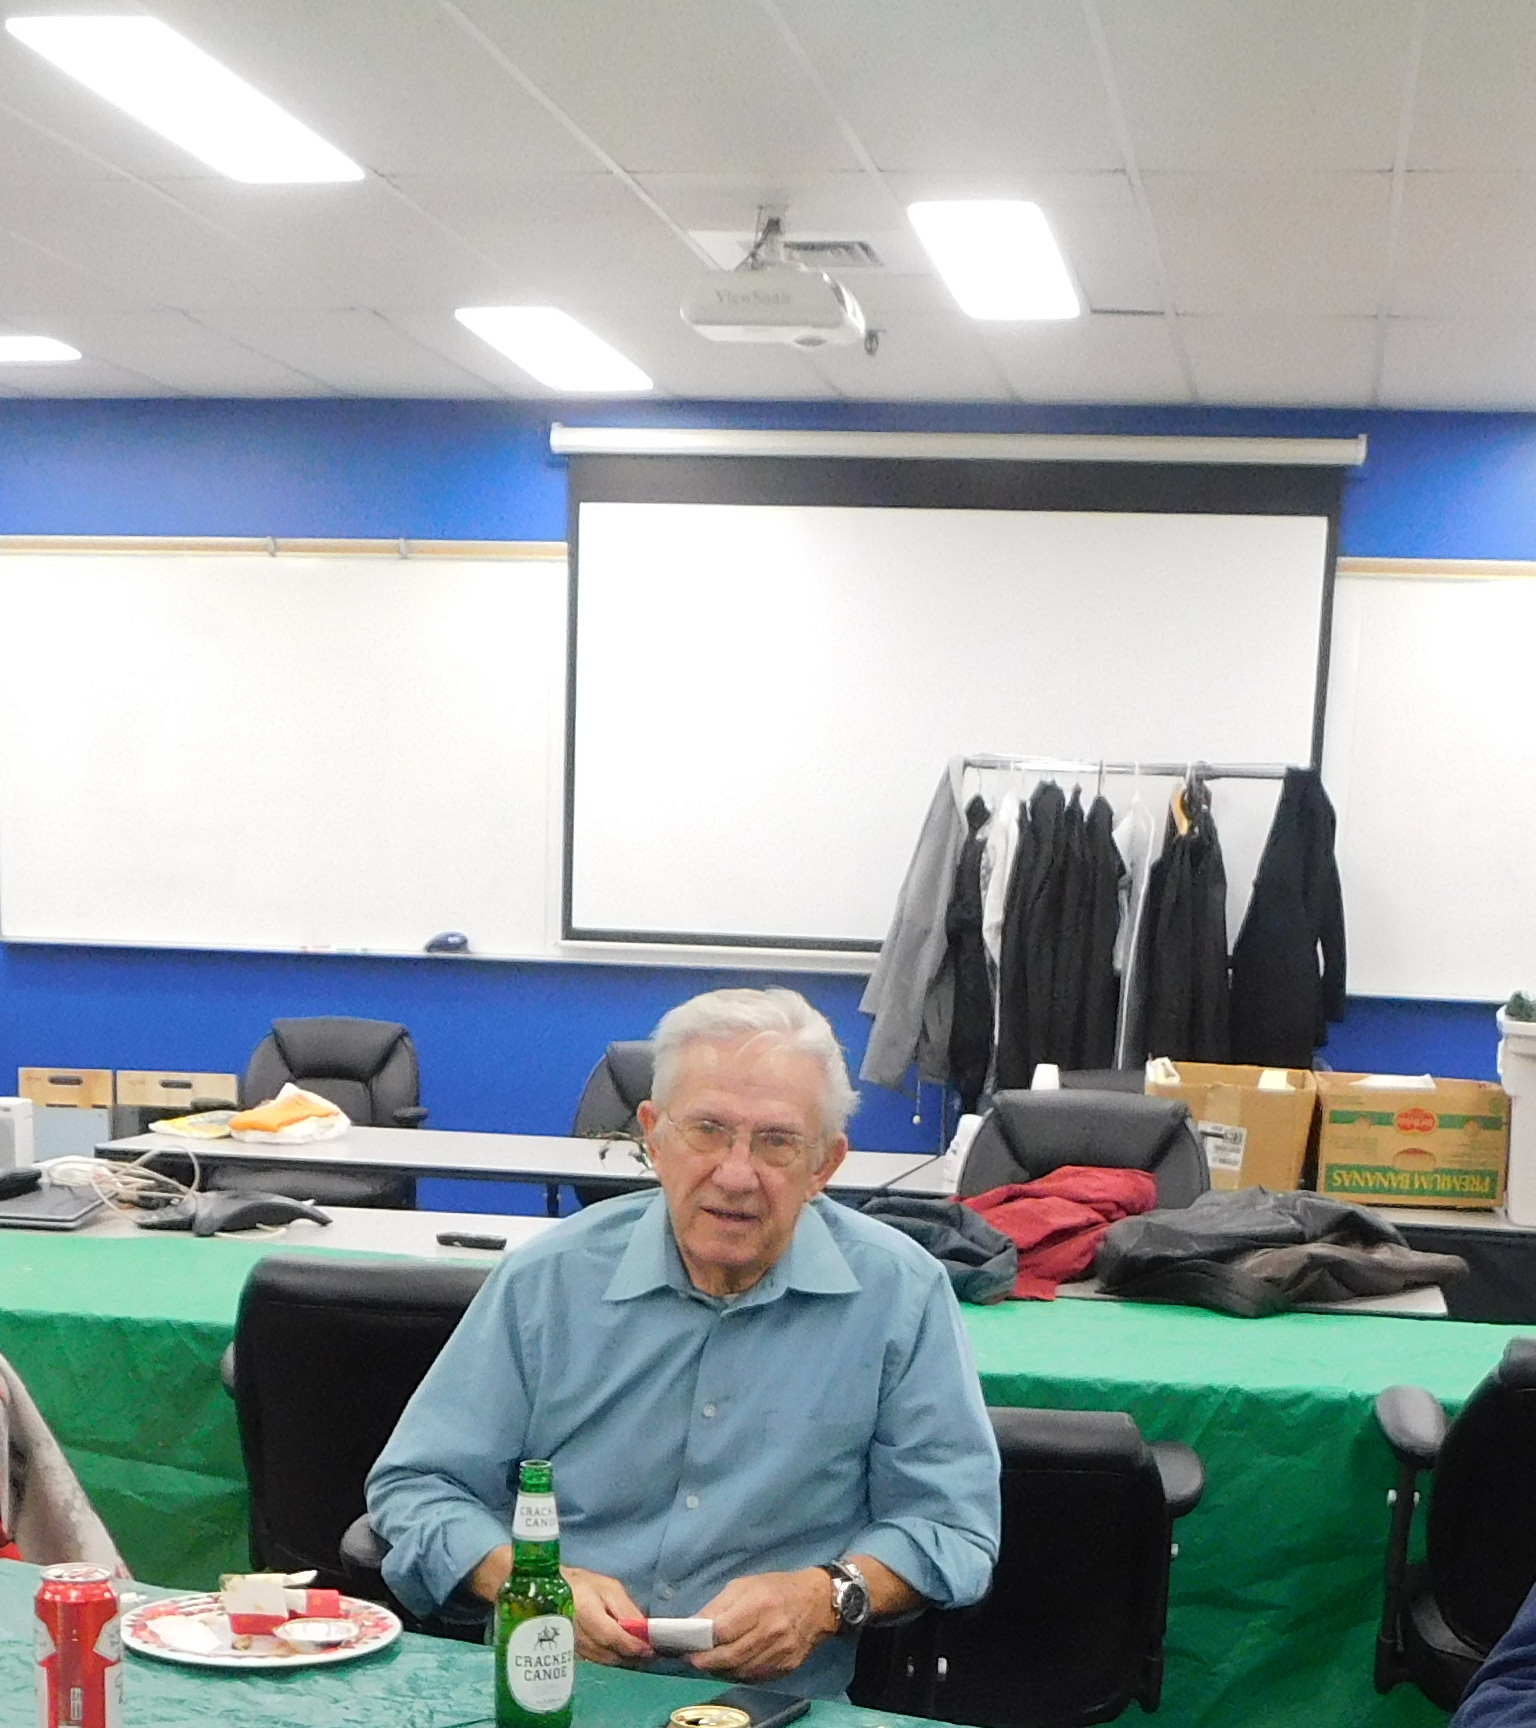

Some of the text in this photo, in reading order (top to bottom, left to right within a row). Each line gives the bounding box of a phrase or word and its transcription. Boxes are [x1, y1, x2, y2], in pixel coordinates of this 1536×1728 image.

[1332, 1170, 1491, 1193] PREMIUM BANANAS
[524, 1665, 567, 1682] CANOE
